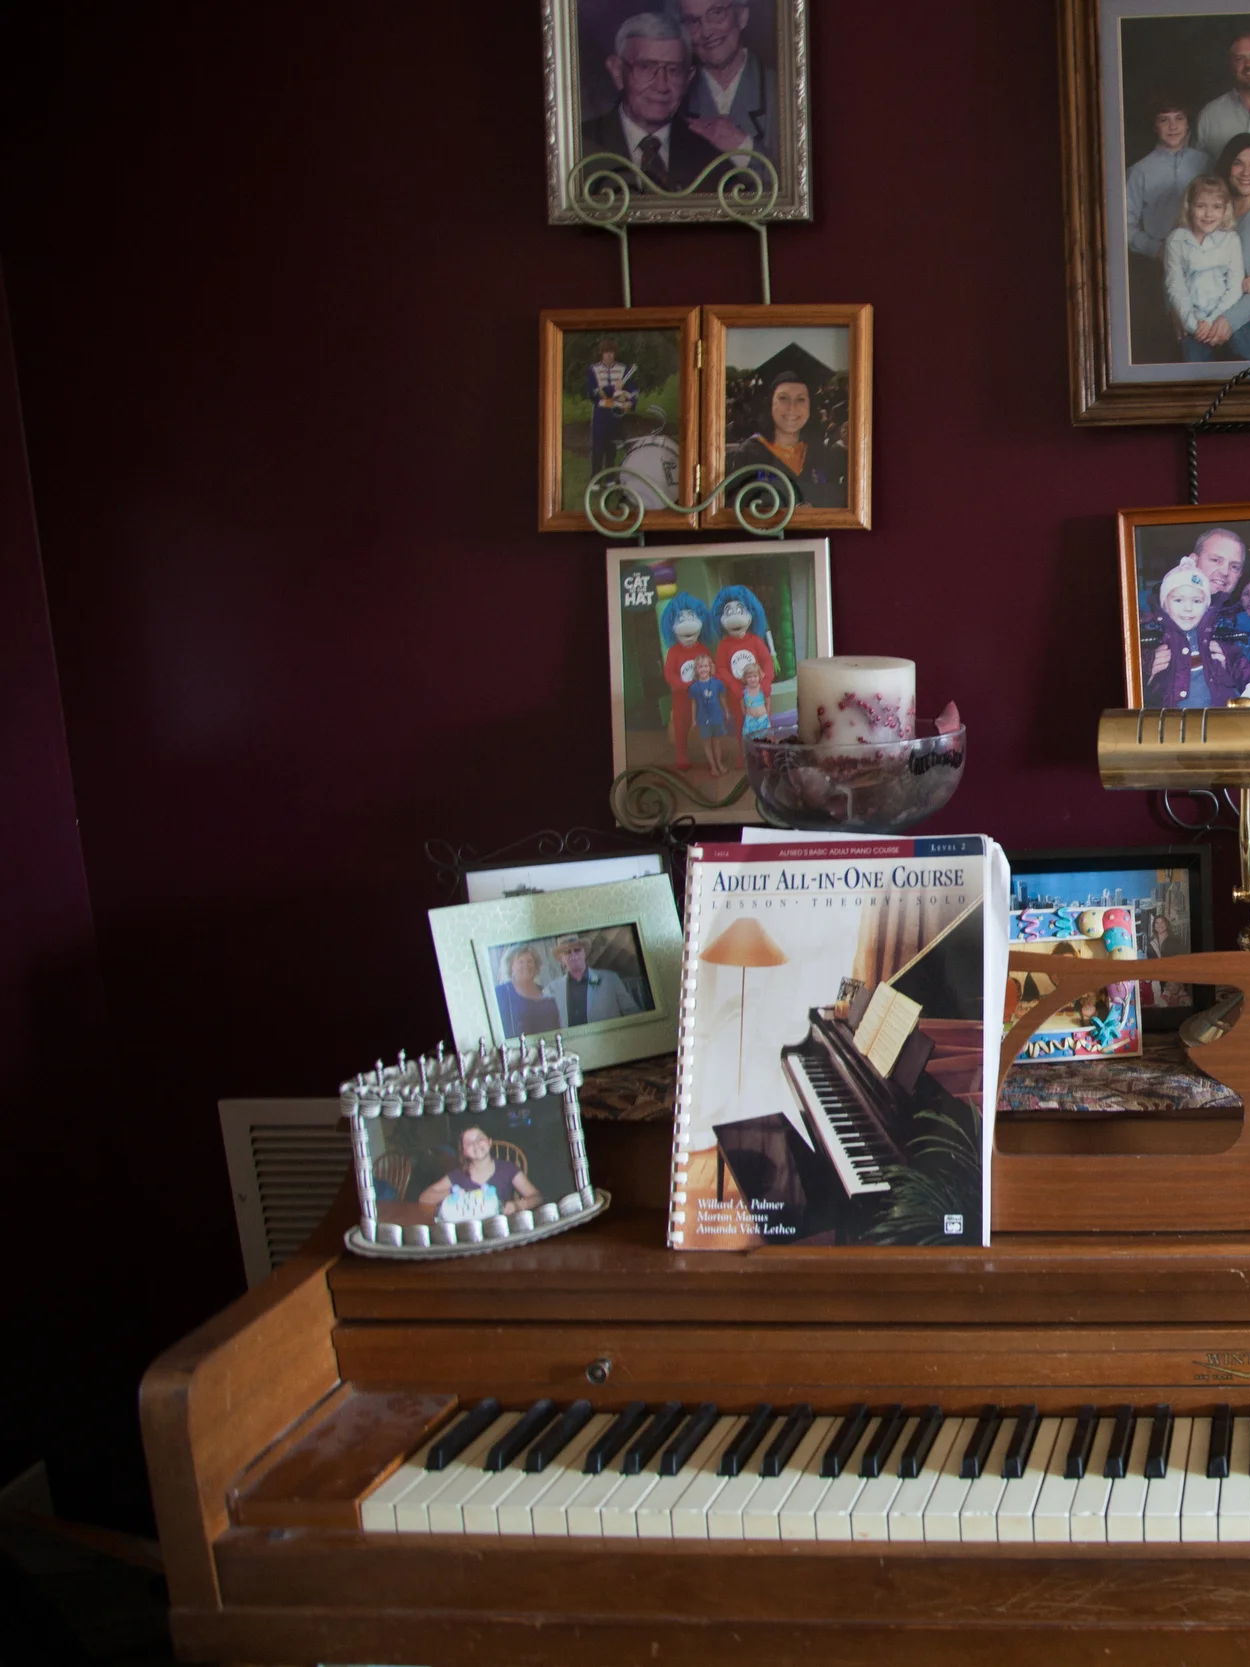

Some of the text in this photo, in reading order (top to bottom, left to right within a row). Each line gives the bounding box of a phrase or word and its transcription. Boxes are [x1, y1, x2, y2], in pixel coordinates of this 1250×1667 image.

[624, 575, 650, 591] CAT
[624, 591, 655, 607] HAT
[808, 847, 828, 857] BASIC
[829, 847, 849, 856] ADULT
[850, 846, 872, 856] PIANO
[873, 845, 900, 855] COURSE
[930, 842, 966, 852] LEVEL 2
[712, 864, 965, 892] ADULT ALL-IN-ONE COURSE
[712, 895, 966, 910] LESSON THEORY SOLO
[697, 1198, 785, 1210] Willard A. Palmer
[697, 1210, 769, 1222] Morton Manus
[696, 1223, 796, 1236] Amanda Vick Lethco
